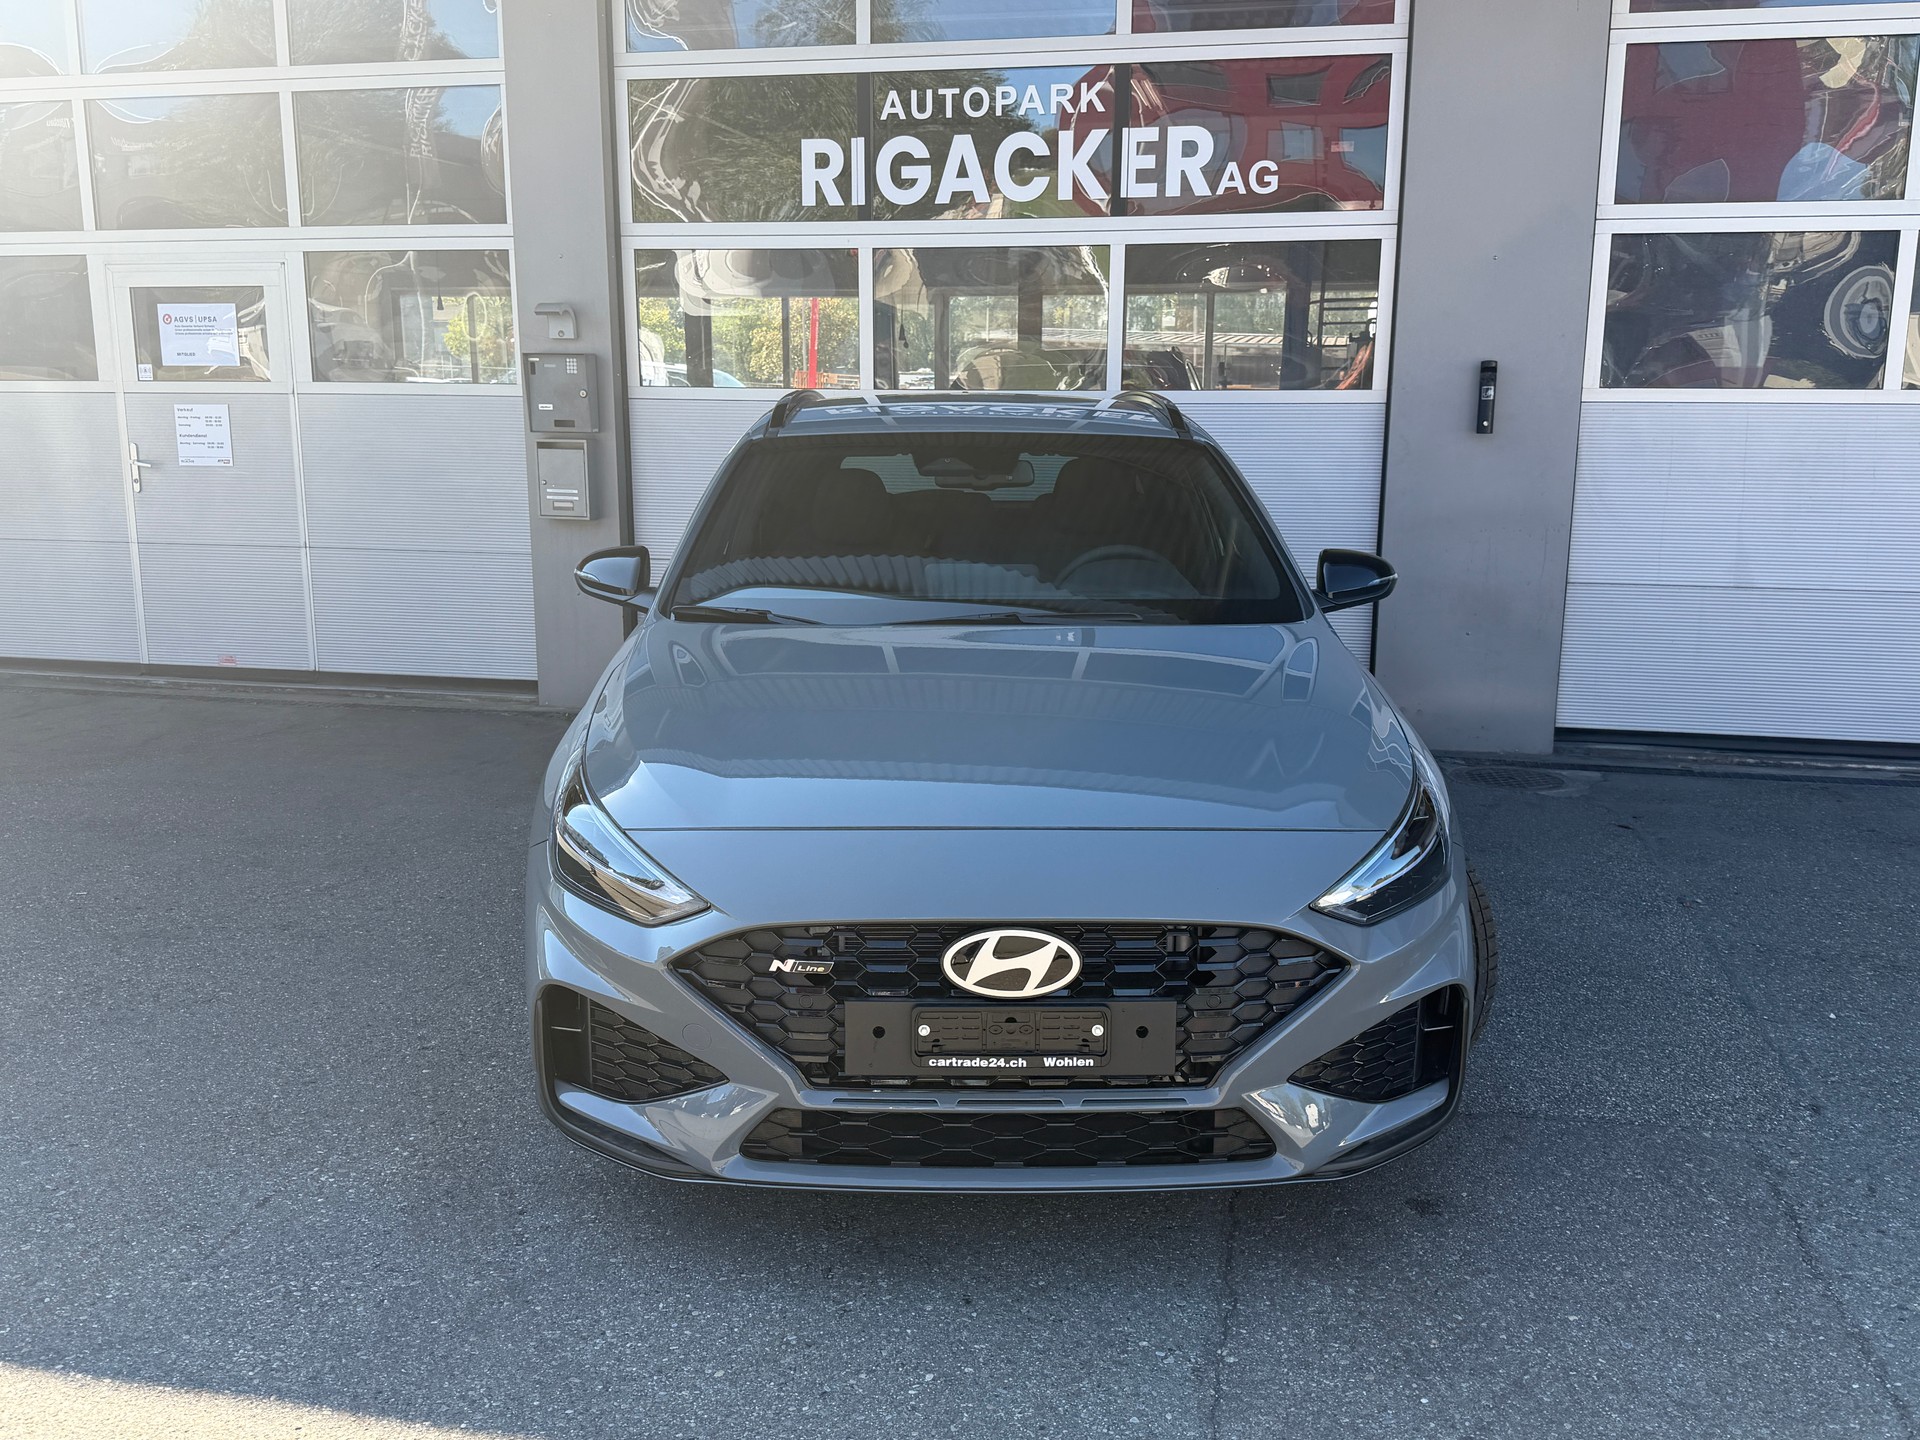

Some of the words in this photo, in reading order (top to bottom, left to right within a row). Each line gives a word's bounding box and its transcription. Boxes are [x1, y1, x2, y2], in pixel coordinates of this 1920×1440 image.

[880, 81, 1107, 121] AUTOPARK
[800, 125, 1215, 207] RIGACKER
[1216, 160, 1279, 195] AG
[769, 959, 796, 972] N
[928, 1057, 1027, 1067] cartrade24.ch
[1043, 1057, 1094, 1067] Wohlen
